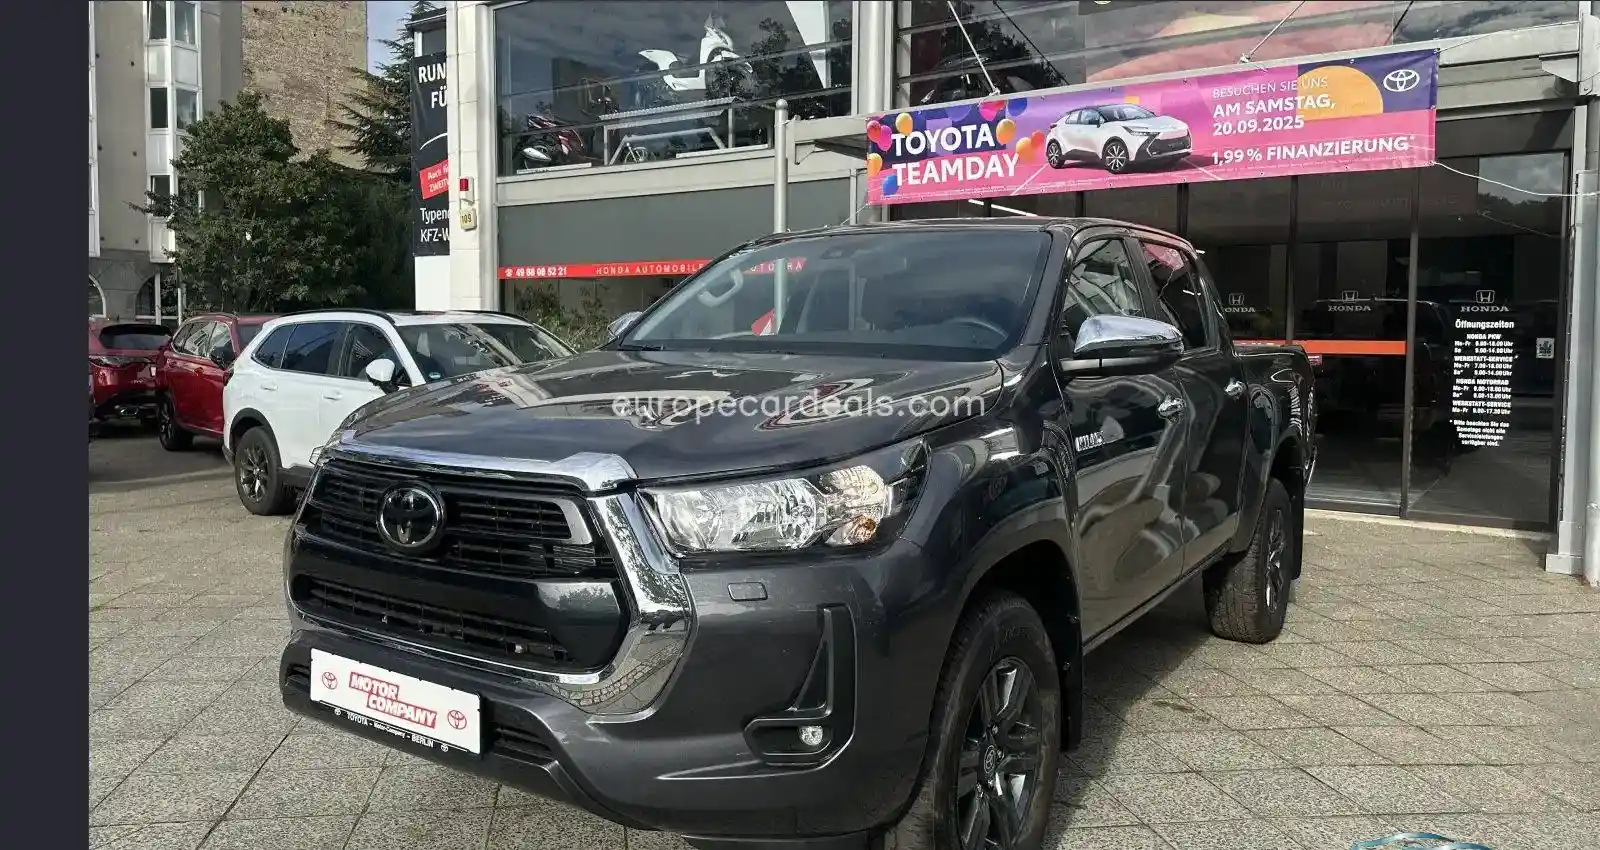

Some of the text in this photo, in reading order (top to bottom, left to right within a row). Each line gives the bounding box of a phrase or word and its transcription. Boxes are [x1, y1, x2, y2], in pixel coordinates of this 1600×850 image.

[1212, 75, 1328, 99] BESUCHEN SIE UNS
[1212, 93, 1337, 119] AM SAMSTAG,
[1212, 115, 1305, 136] 20.09.2025
[891, 123, 996, 157] TOYOTA
[1211, 148, 1244, 166] 1,99
[1246, 148, 1263, 162] %
[892, 153, 1020, 186] TEAMDAY
[516, 267, 525, 277] 49
[547, 266, 557, 276] 52
[557, 266, 567, 276] 21
[596, 265, 631, 275] HONDA
[1328, 304, 1372, 312] HONDA
[1460, 305, 1510, 313] HONDA
[1454, 318, 1515, 330] Öffnungszeiten
[350, 673, 399, 699] MOTOR
[368, 695, 437, 728] COMPANY
[346, 711, 369, 726] TOYOTA
[411, 733, 434, 748] BERLIN
